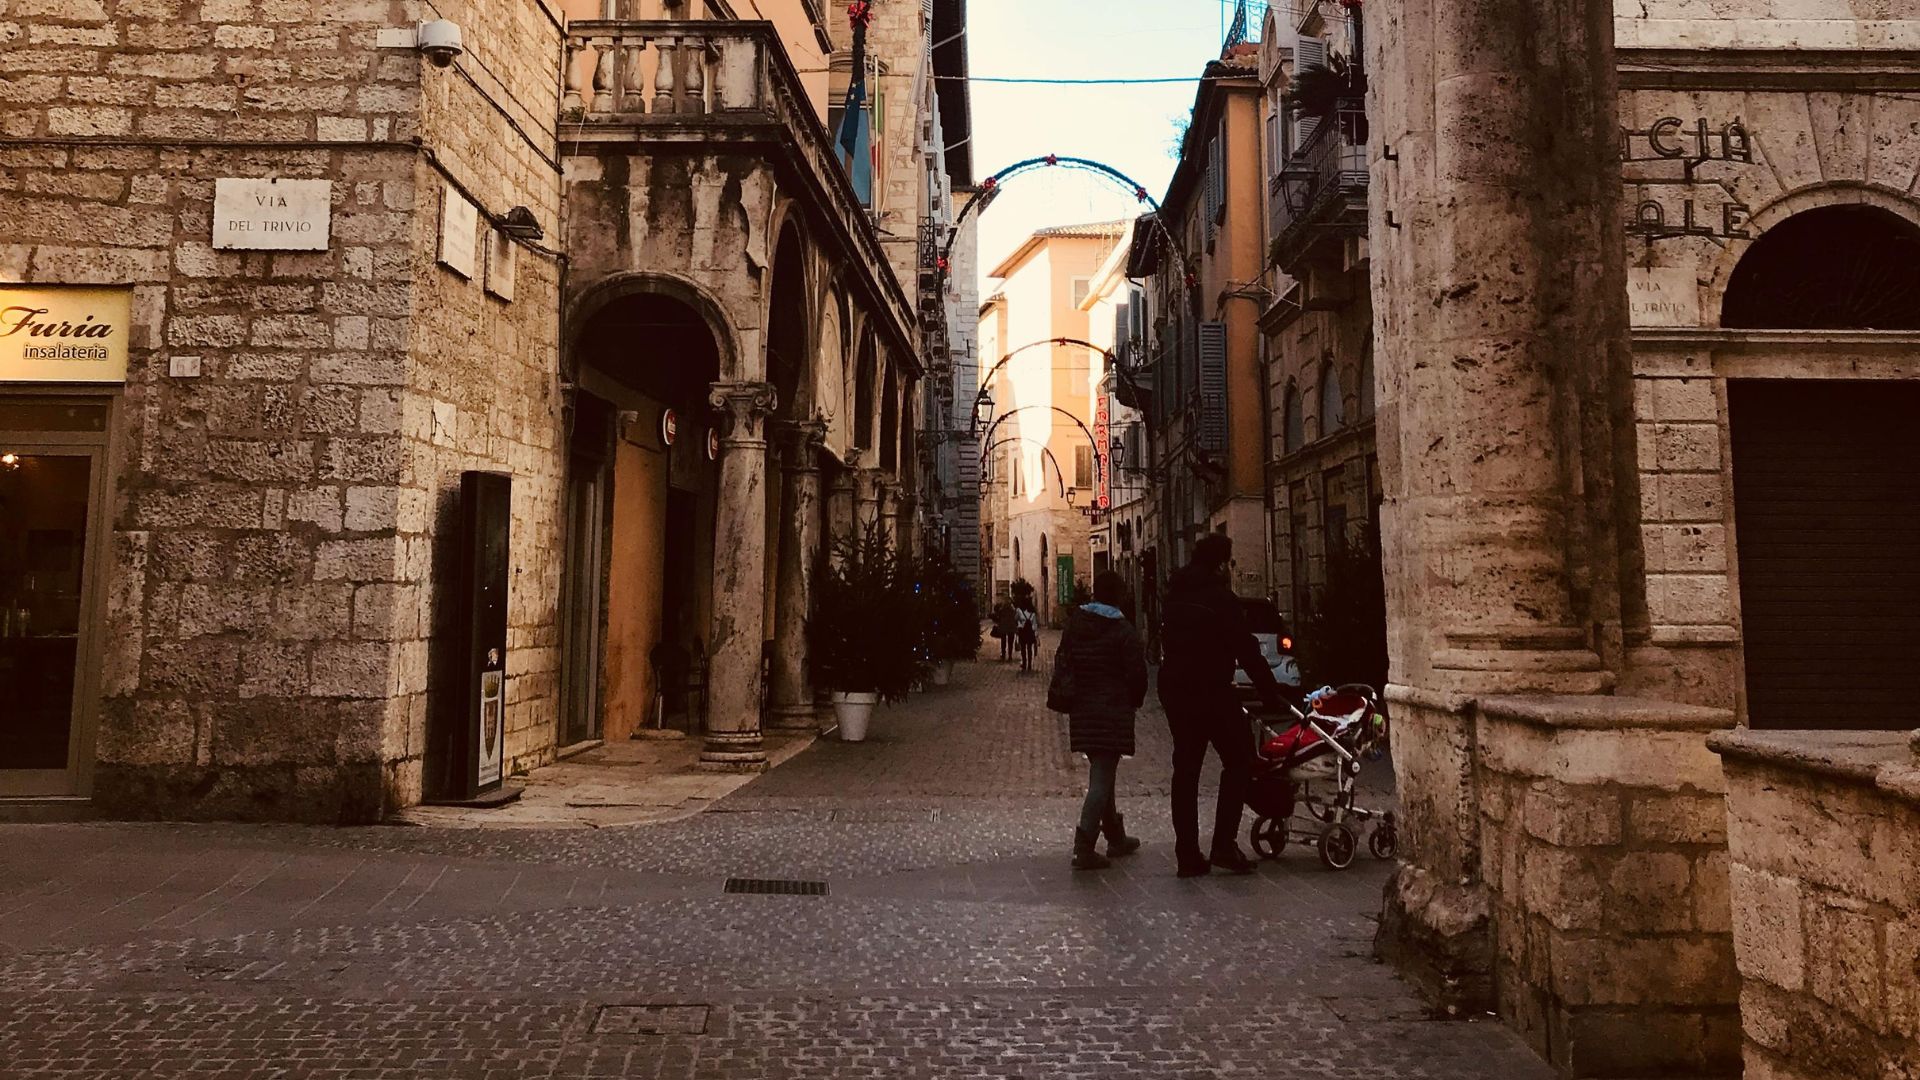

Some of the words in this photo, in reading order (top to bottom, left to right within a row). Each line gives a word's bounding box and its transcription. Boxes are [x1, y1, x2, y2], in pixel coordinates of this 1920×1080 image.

[256, 196, 288, 208] VIA
[229, 220, 254, 232] DEL
[263, 221, 312, 232] TRIVIO
[1636, 282, 1661, 291] VIA
[1644, 303, 1686, 313] TRIVIO
[0, 306, 114, 338] Furia
[24, 343, 108, 360] insalateria
